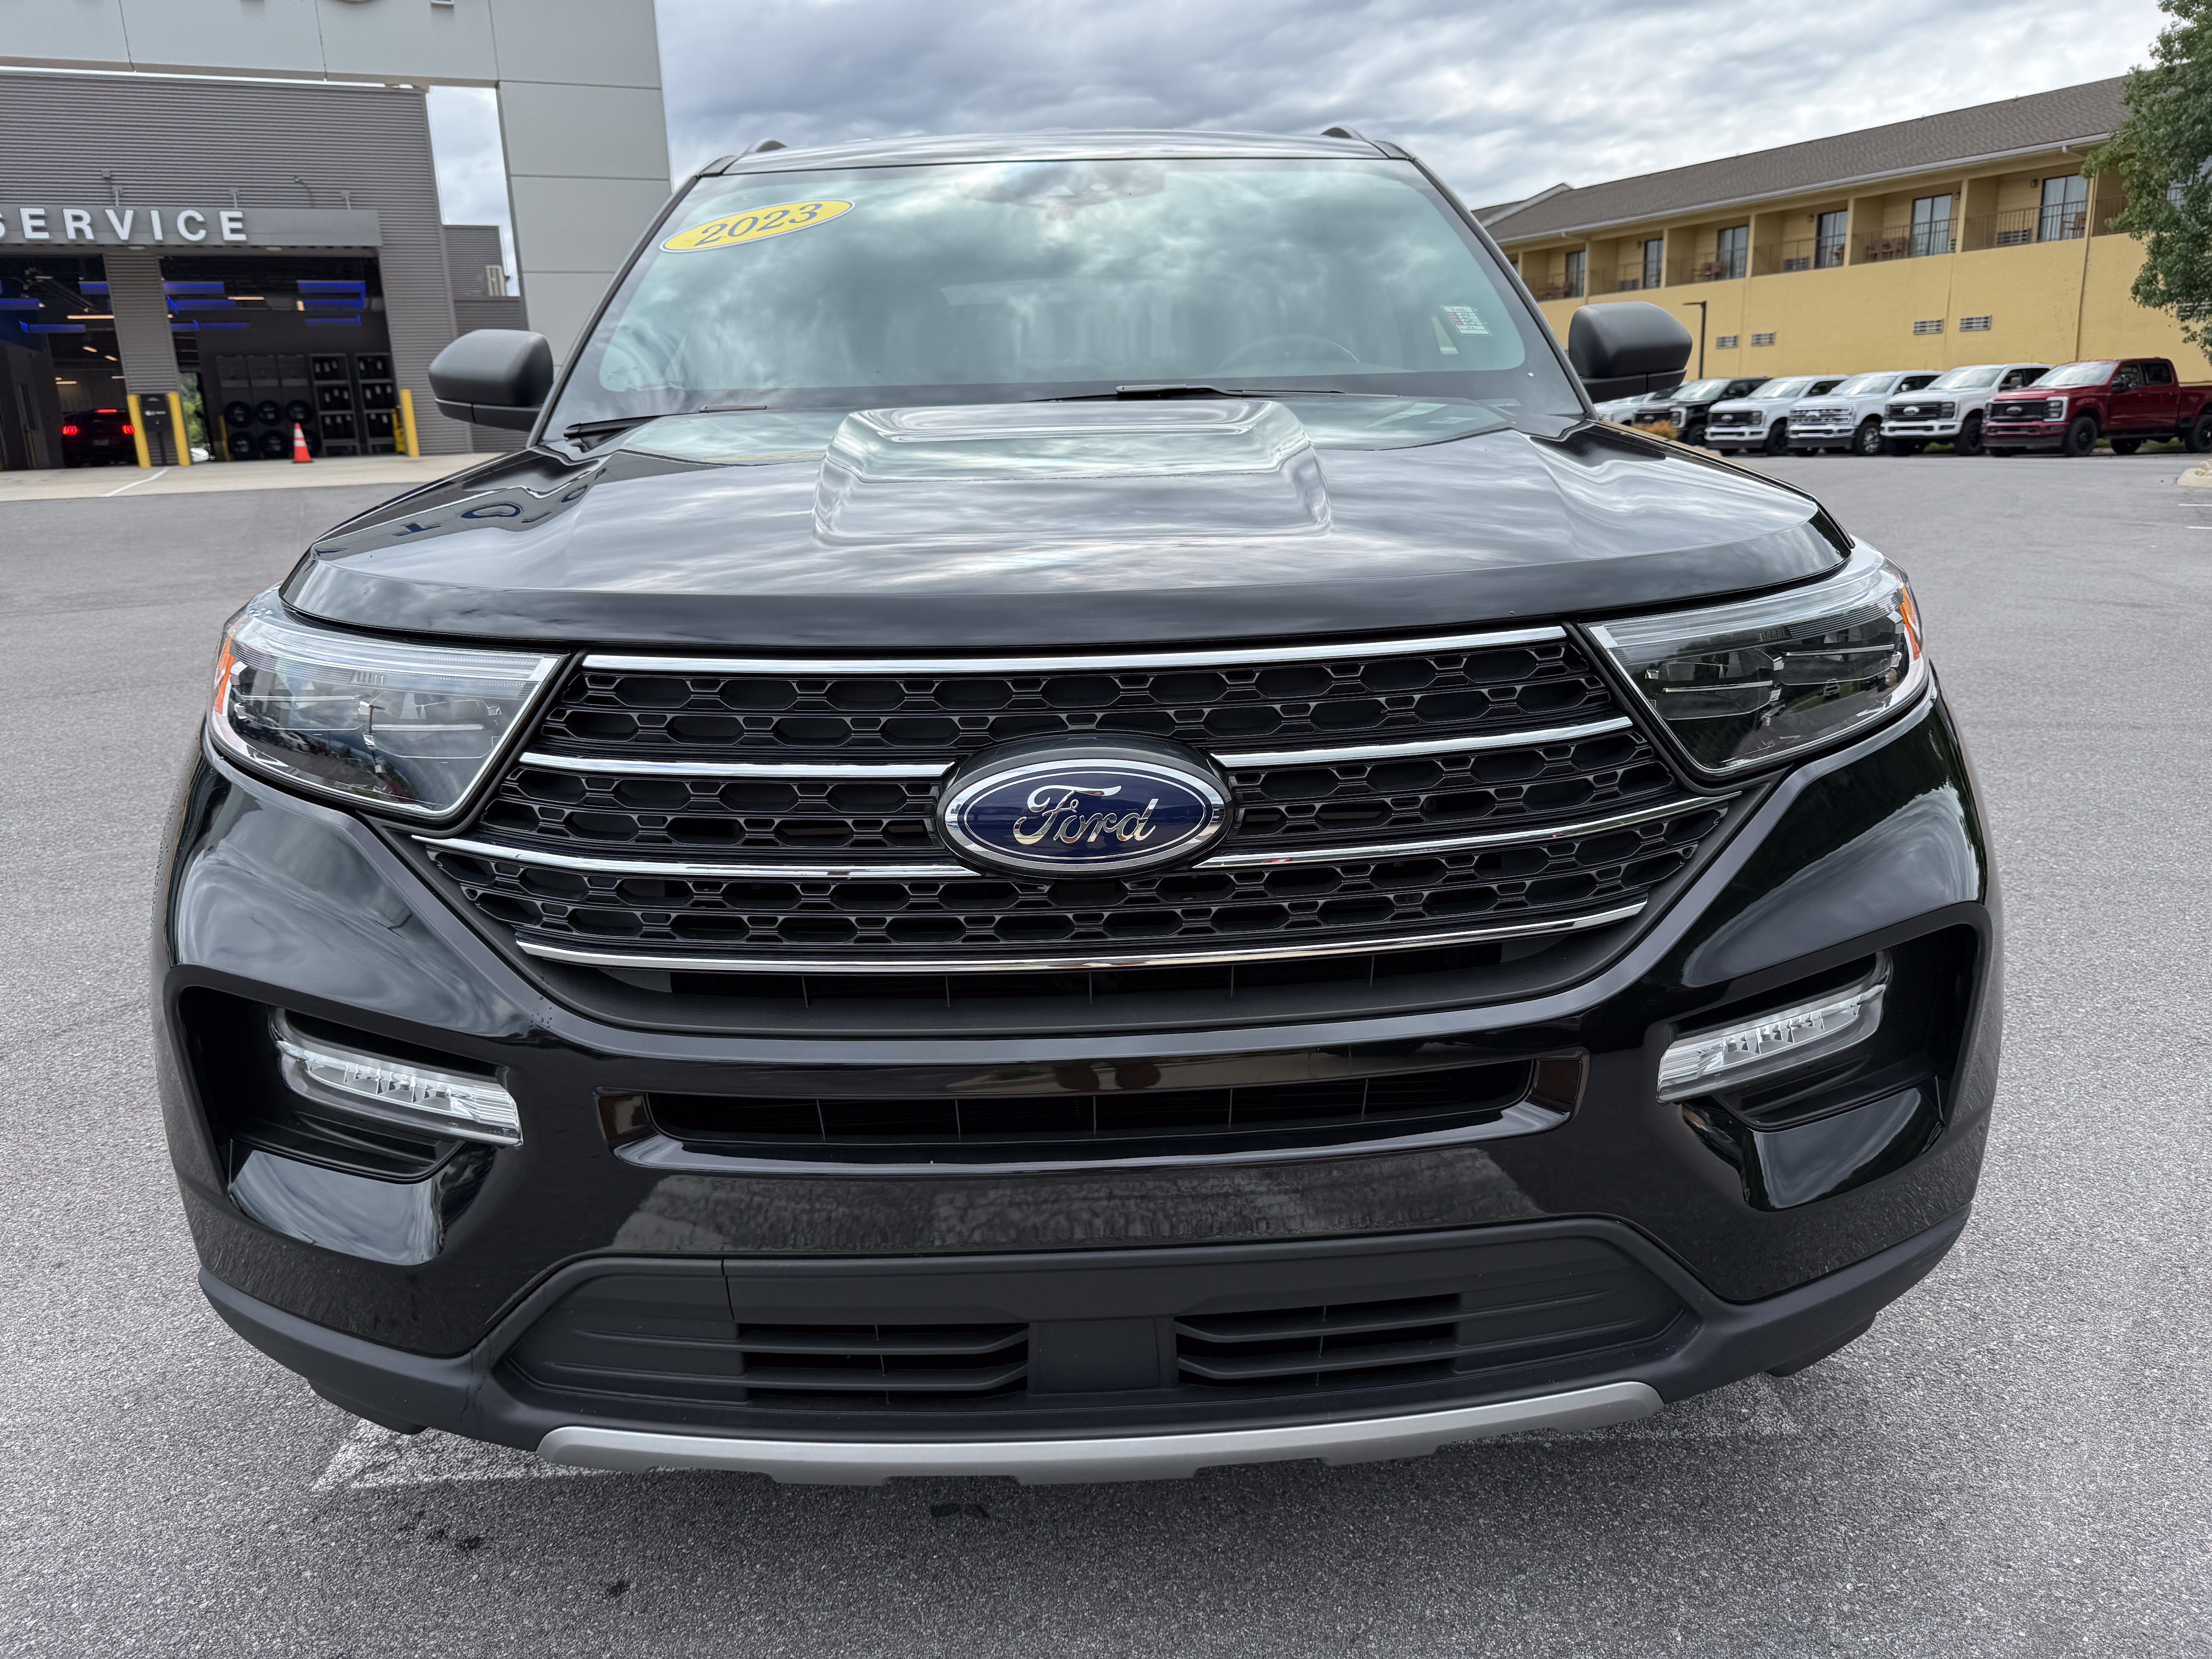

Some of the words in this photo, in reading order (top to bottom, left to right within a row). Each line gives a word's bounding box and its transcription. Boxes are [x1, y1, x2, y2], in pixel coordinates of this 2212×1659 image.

[0, 207, 247, 242] ERVICE
[694, 203, 823, 246] 2023
[1013, 785, 1159, 845] Ford
